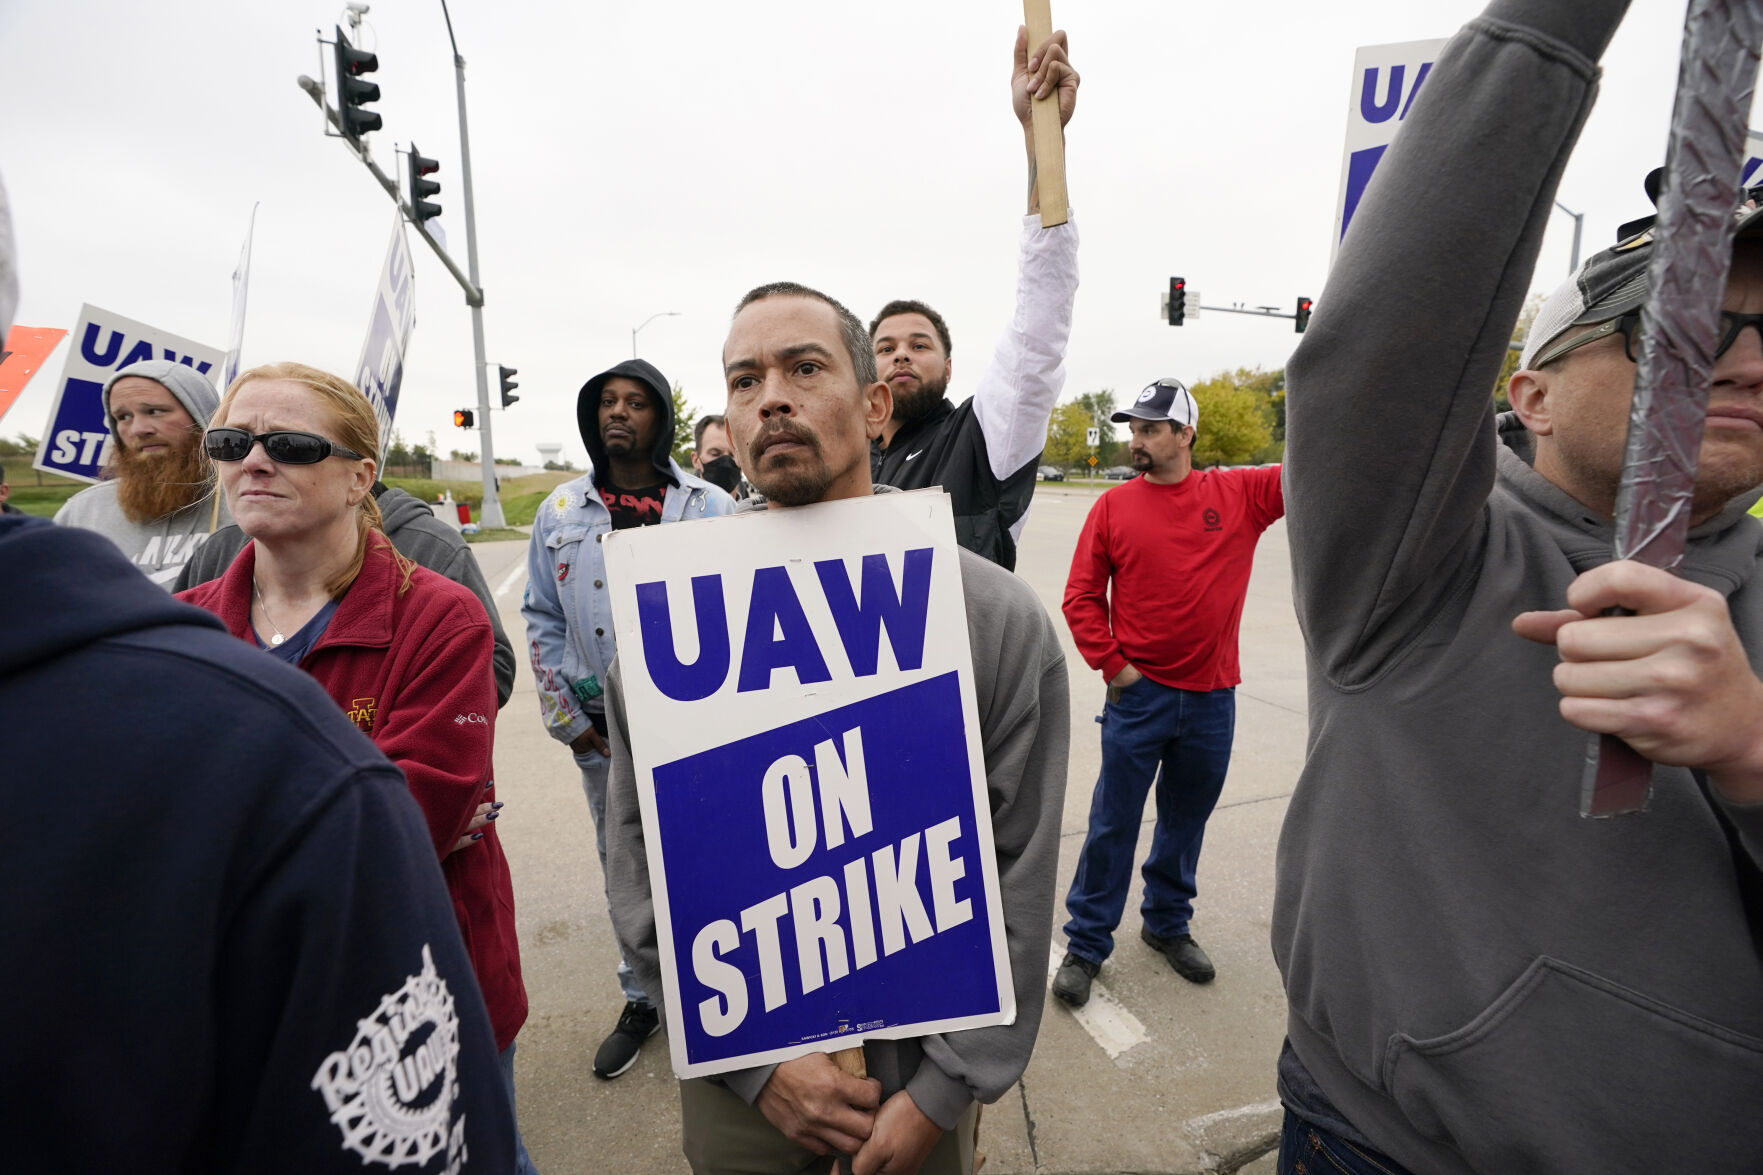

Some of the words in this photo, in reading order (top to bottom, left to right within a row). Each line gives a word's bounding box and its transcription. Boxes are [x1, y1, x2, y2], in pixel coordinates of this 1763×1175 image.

[139, 533, 210, 565] NIK
[635, 547, 934, 702] UAW
[762, 726, 874, 870] ON
[691, 815, 973, 1038] STRIKE
